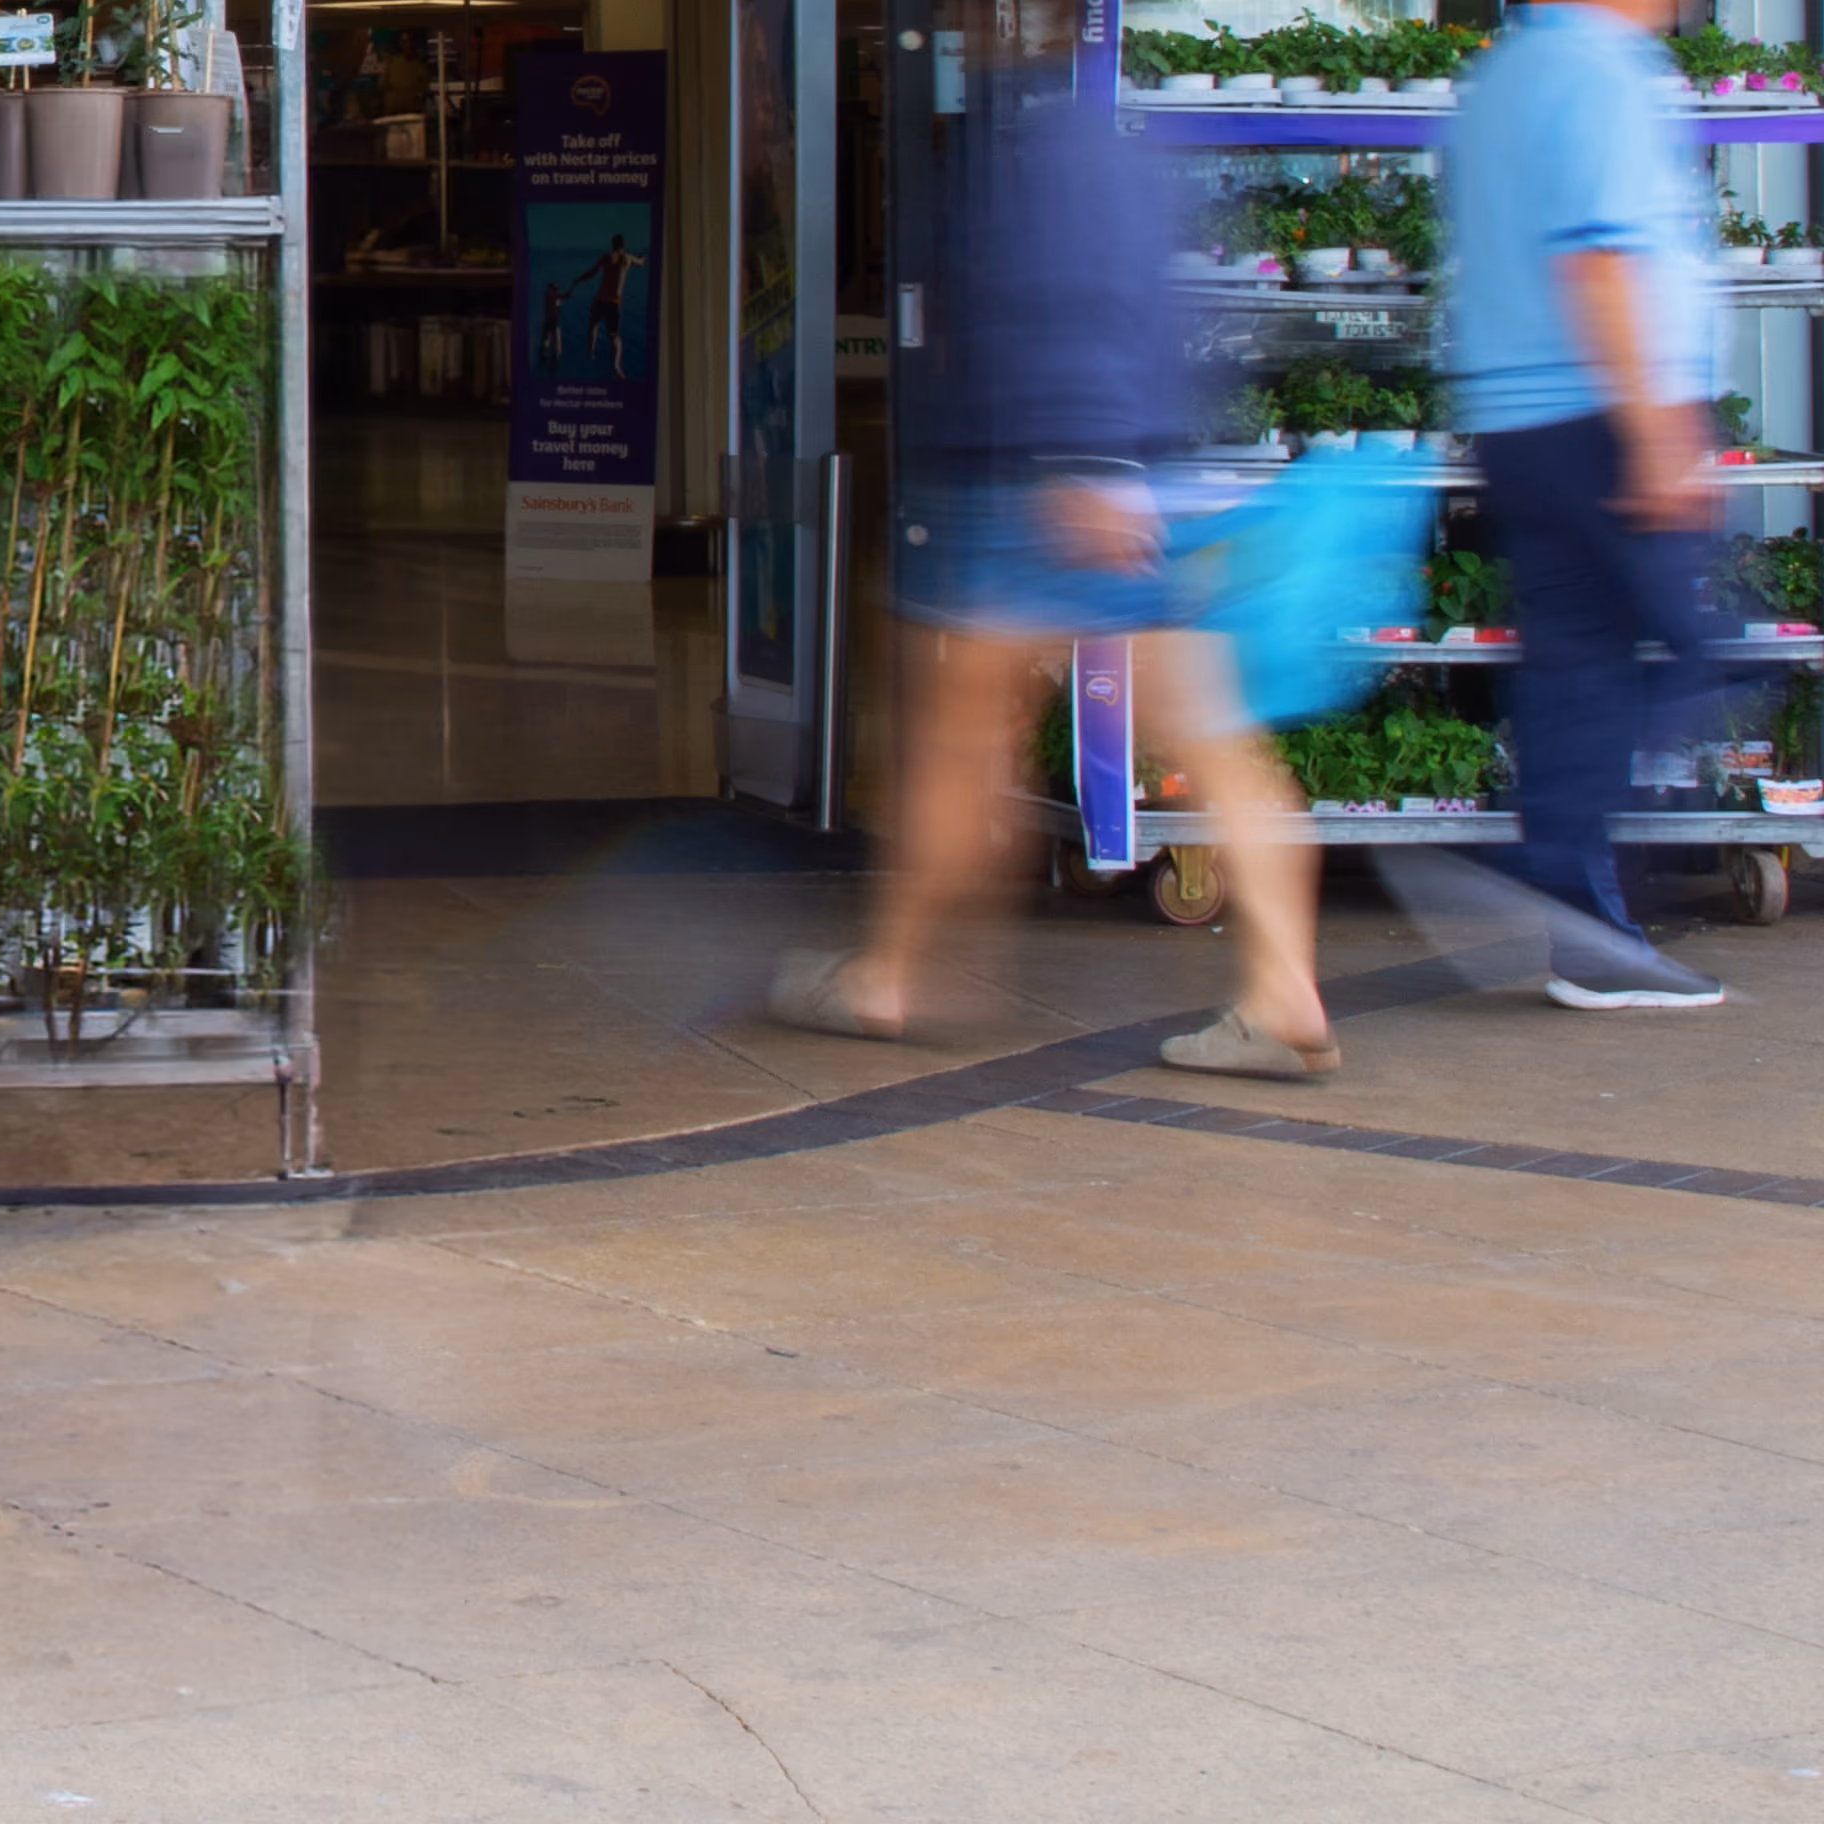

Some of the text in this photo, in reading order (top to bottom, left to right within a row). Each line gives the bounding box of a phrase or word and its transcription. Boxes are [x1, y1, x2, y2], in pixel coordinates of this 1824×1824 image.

[561, 133, 622, 149] Take off
[524, 152, 657, 170] with Nectar prices
[531, 170, 648, 188] on travel money
[547, 420, 614, 438] Buy your
[532, 438, 629, 459] travel money
[562, 455, 596, 471] here
[520, 494, 634, 514] Sainsbury's Bank
